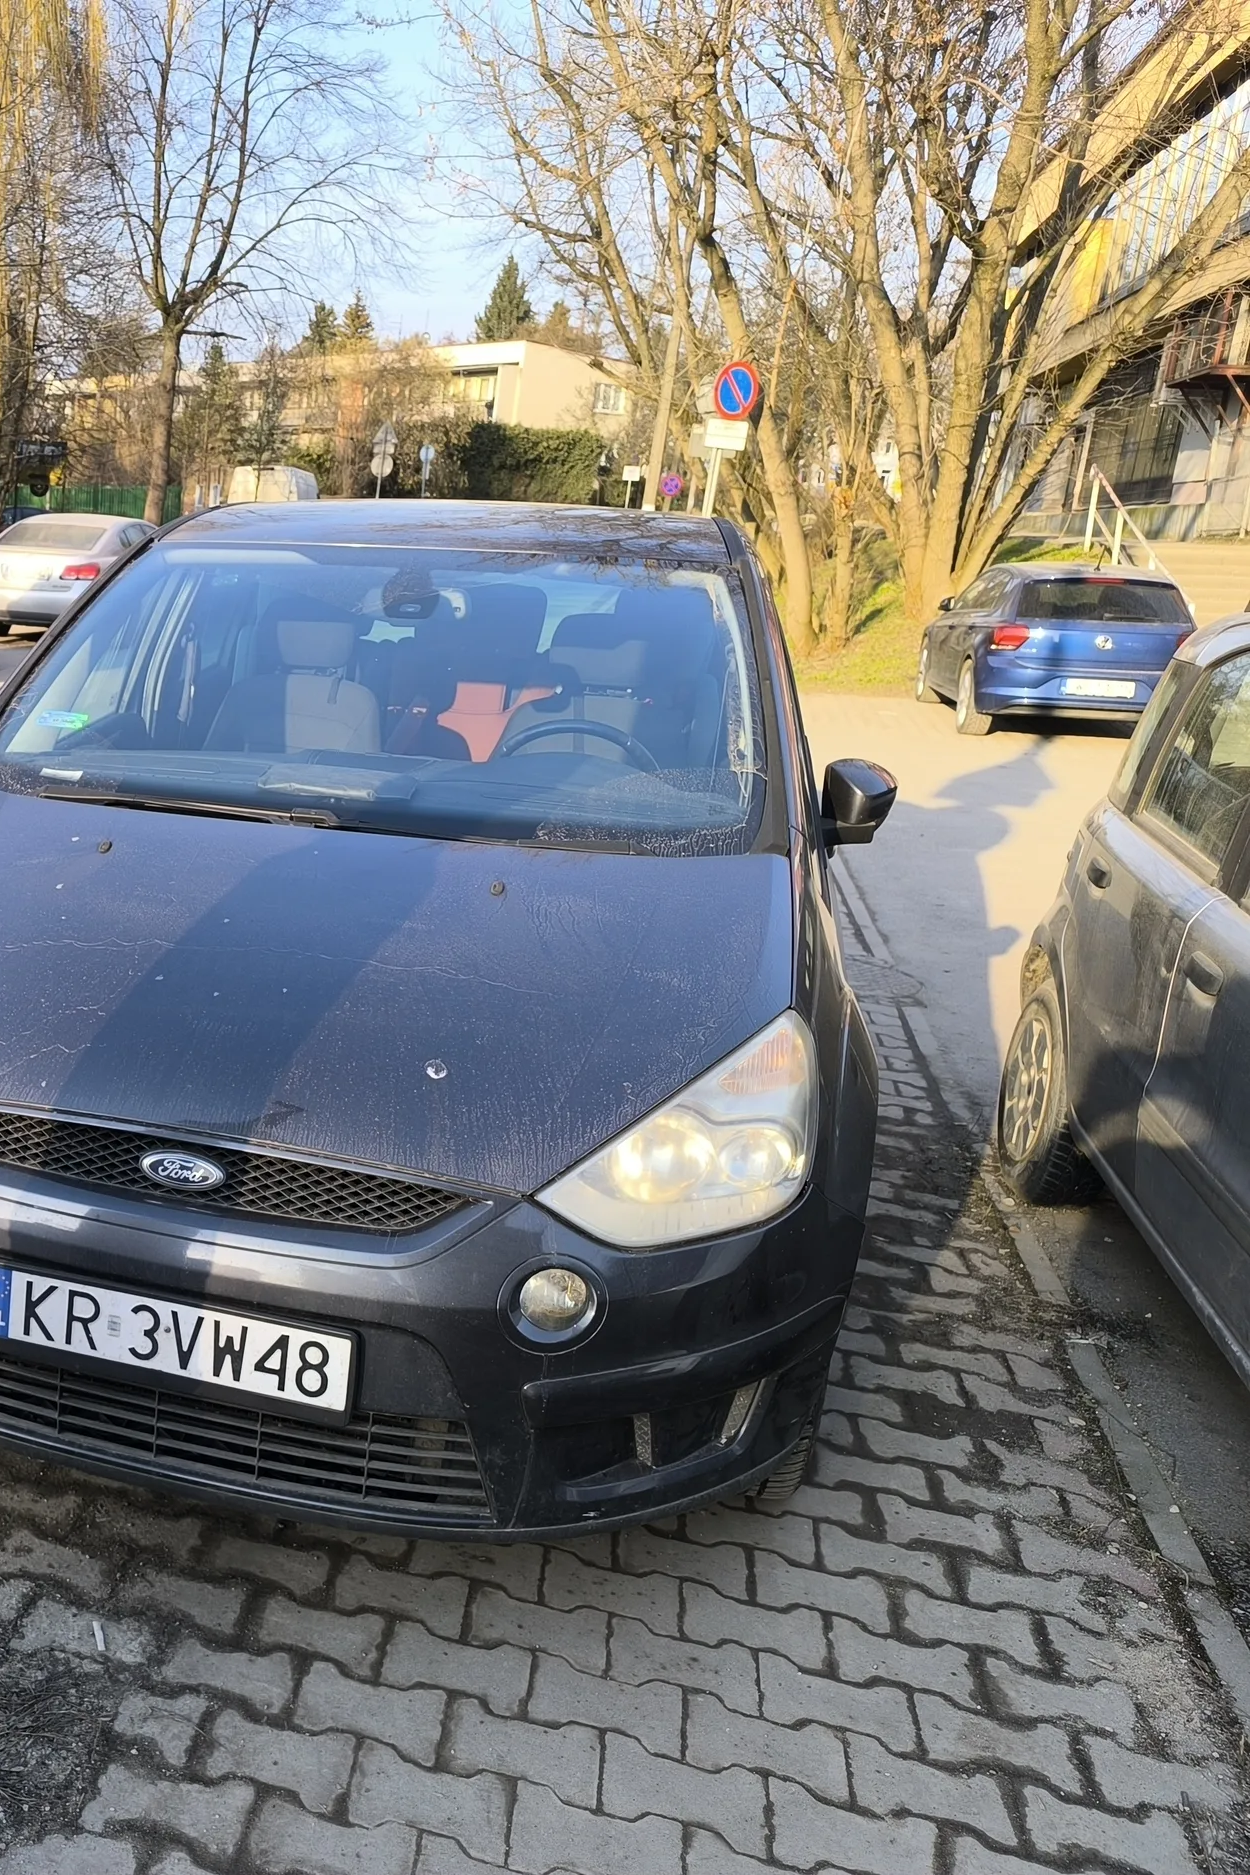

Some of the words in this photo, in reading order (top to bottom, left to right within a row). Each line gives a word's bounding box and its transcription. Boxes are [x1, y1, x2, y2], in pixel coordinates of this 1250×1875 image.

[158, 1158, 205, 1183] Ford
[22, 1280, 101, 1352] KR
[128, 1303, 331, 1399] 3VW48
